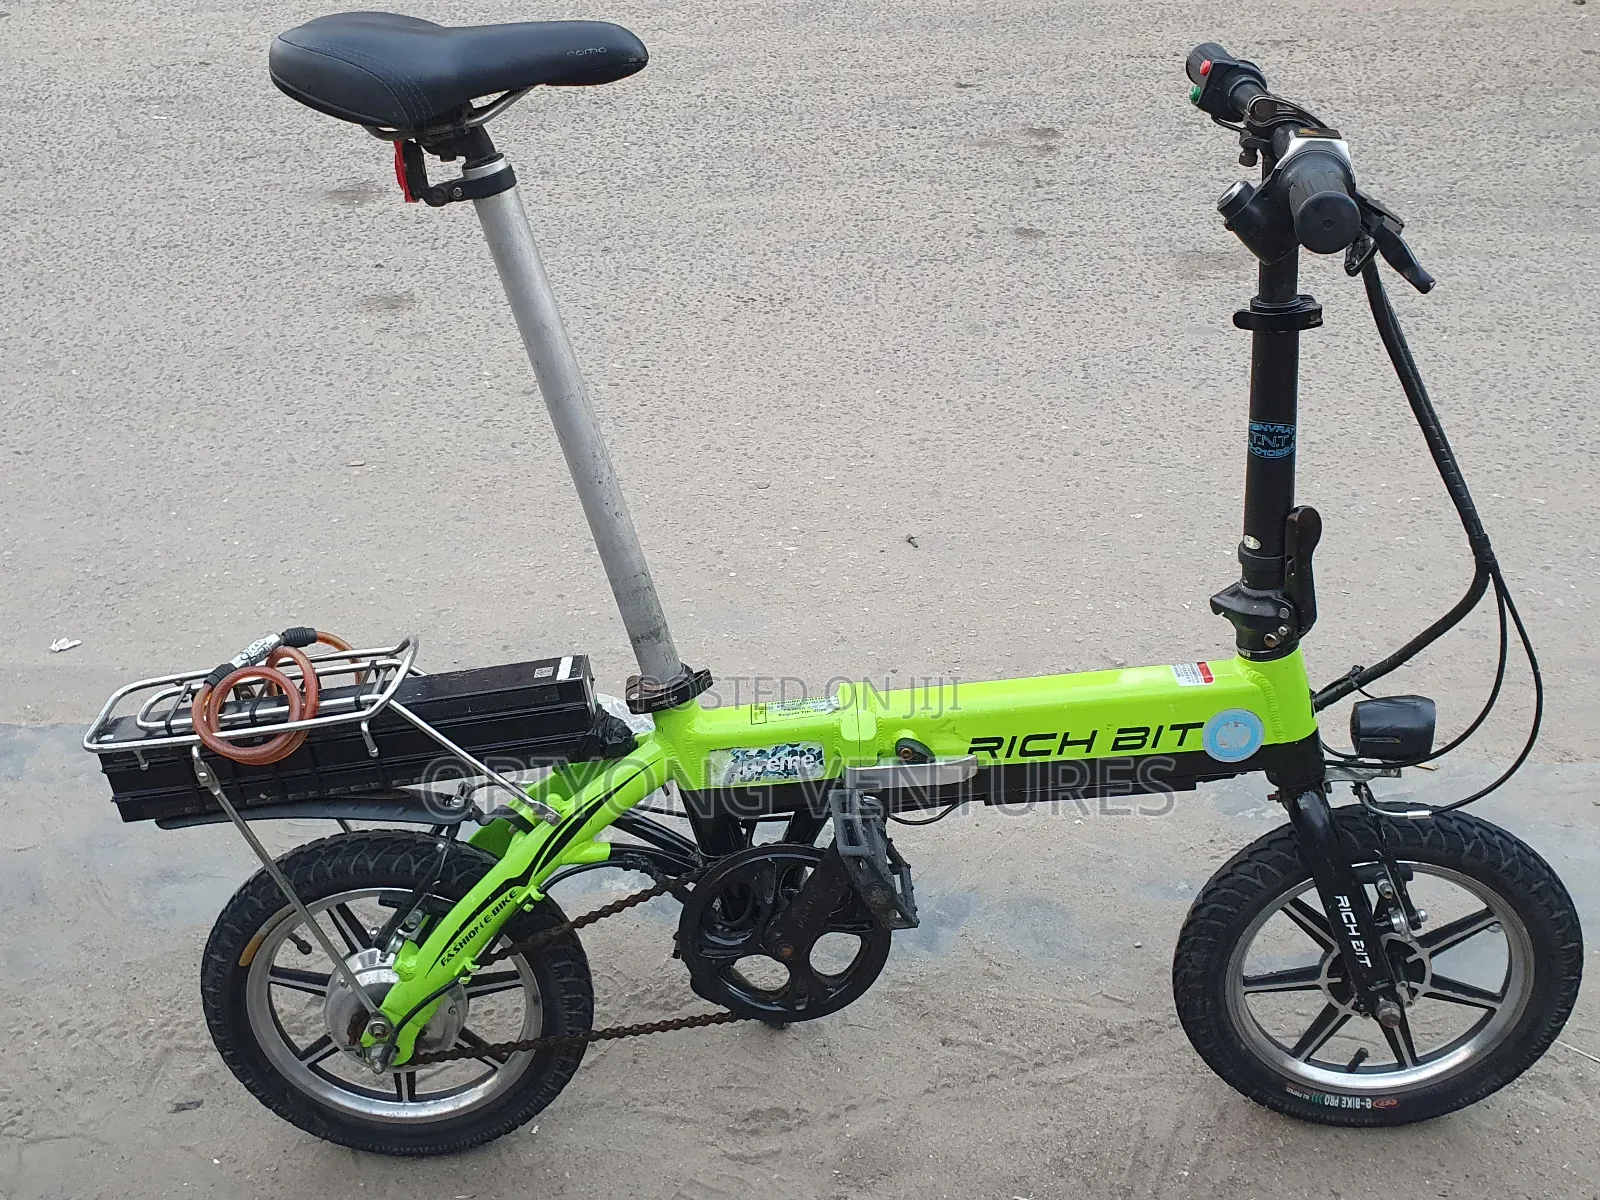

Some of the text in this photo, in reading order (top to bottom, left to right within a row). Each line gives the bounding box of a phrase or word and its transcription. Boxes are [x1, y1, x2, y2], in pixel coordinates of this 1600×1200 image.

[968, 721, 1205, 759] RICH BIT
[1334, 895, 1373, 968] RICH BIT
[1324, 1094, 1339, 1107] PRO
